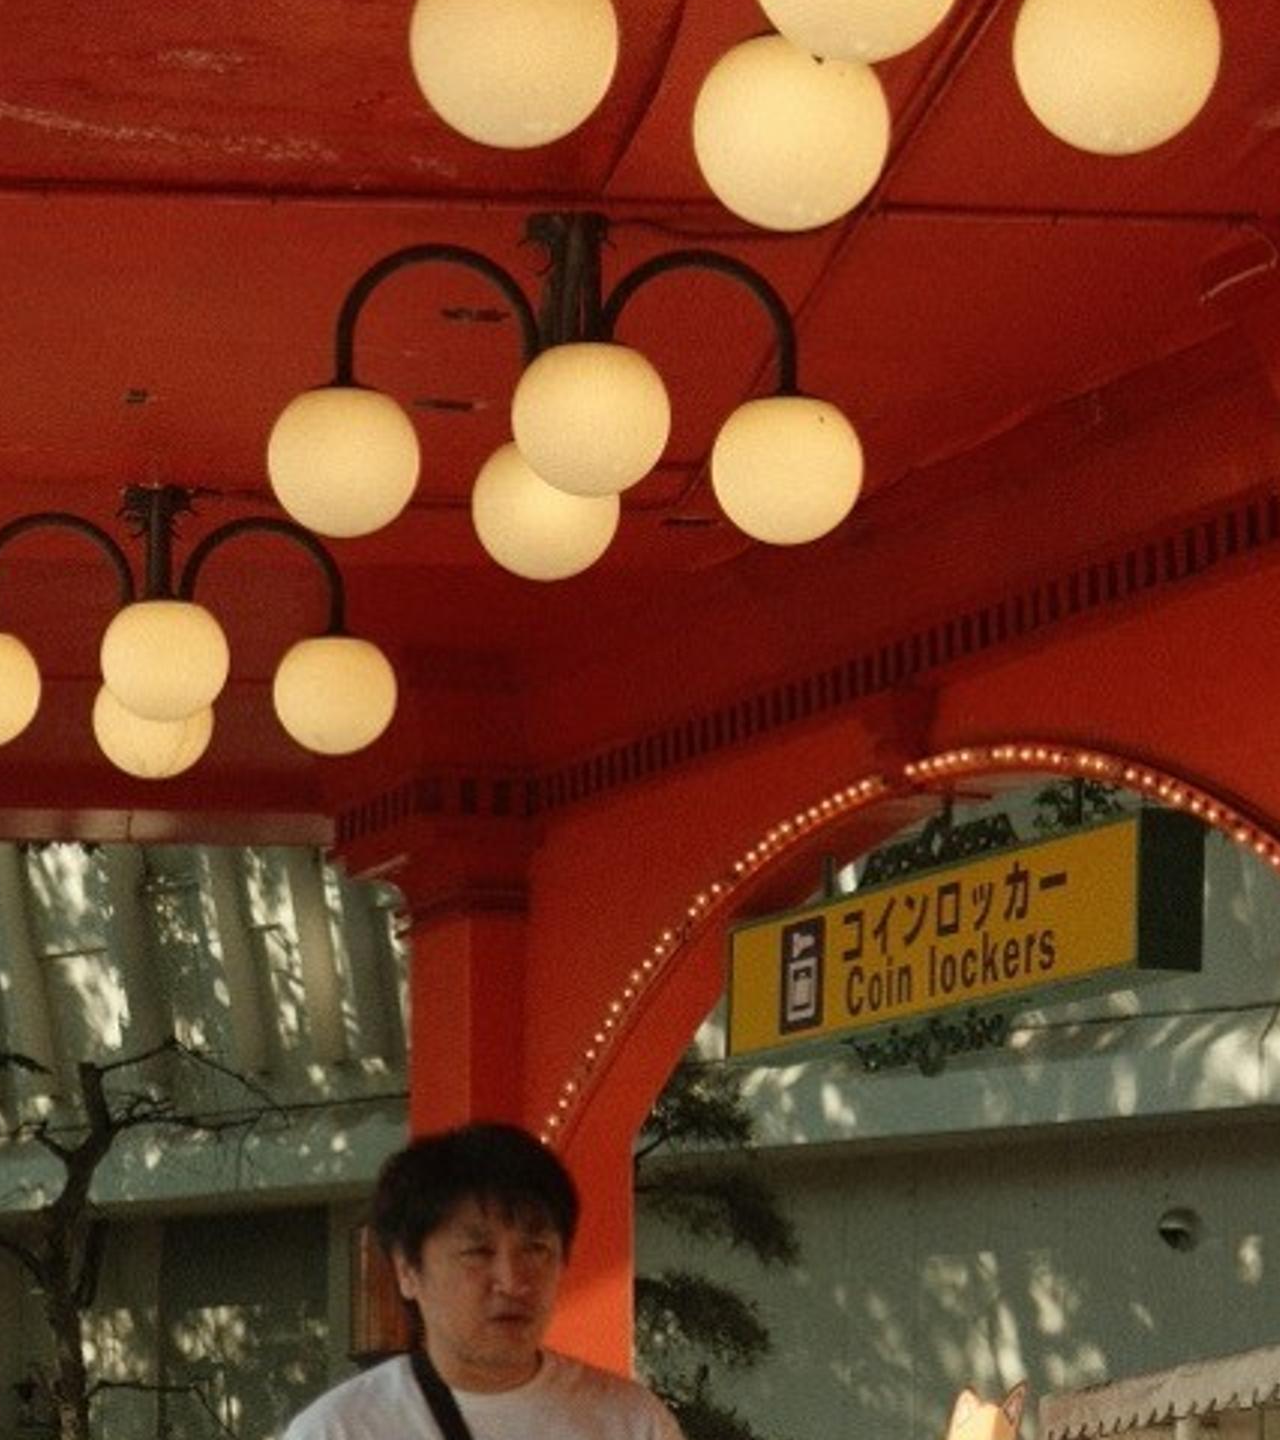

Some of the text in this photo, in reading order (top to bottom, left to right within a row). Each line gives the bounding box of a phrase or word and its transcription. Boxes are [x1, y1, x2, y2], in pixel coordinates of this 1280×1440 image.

[841, 860, 1068, 962] コインロッカー
[846, 928, 1057, 1016] Coin lockers
